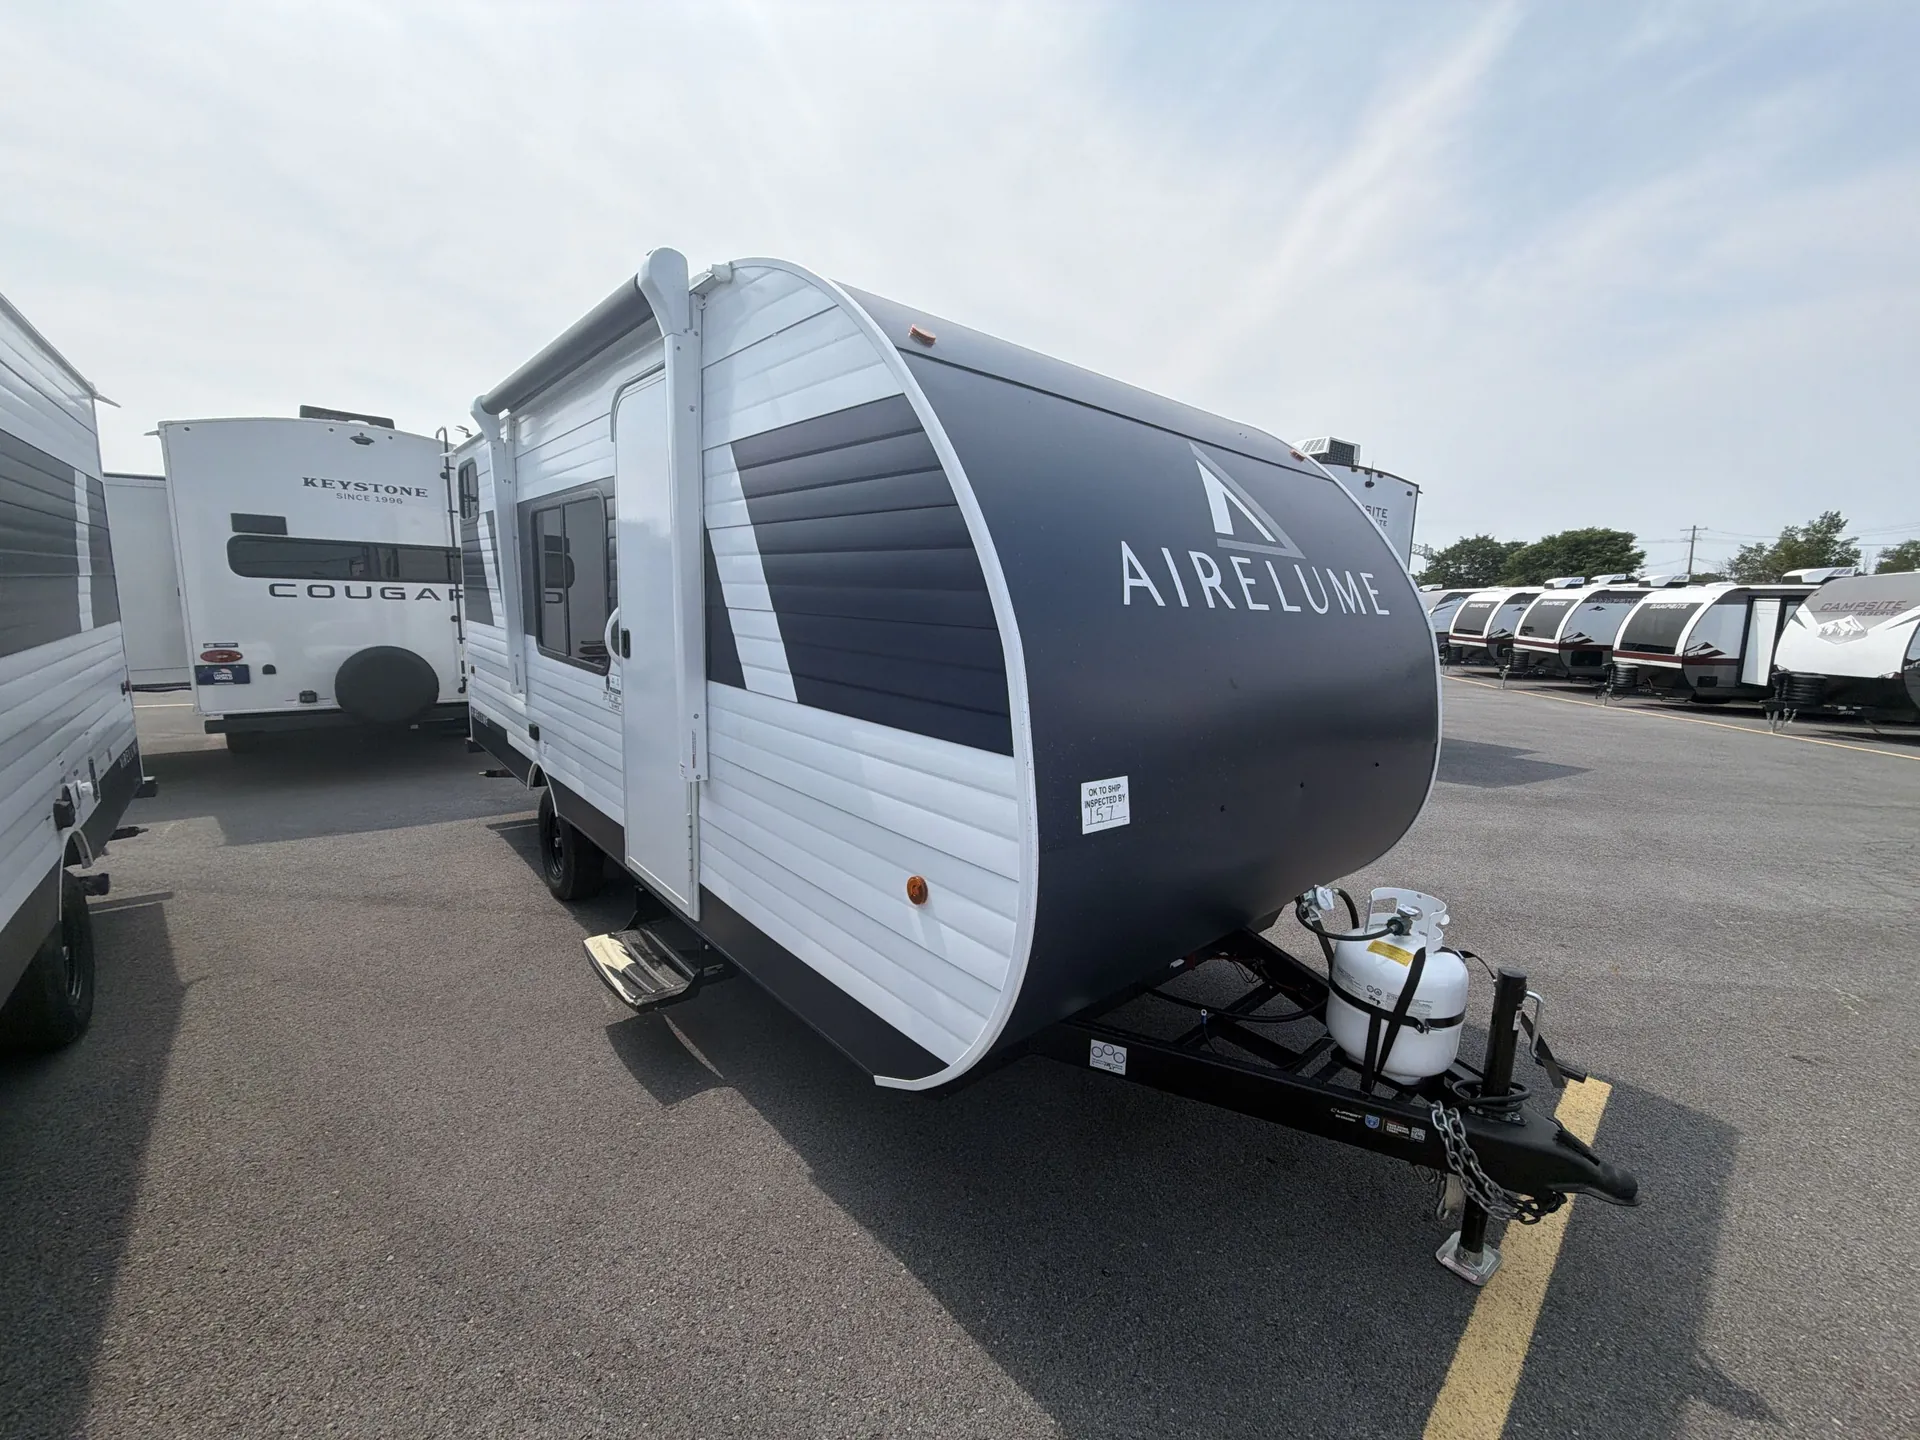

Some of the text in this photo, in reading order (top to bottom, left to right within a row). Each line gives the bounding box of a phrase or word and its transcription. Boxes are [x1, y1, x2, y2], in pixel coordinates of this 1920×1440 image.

[302, 476, 428, 498] KEYSTONE
[336, 492, 403, 505] SINCE 1996
[1365, 505, 1388, 518] SITE
[1121, 540, 1390, 616] AIRELUME
[1820, 600, 1907, 611] CAMPSITE
[1088, 784, 1121, 797] OK TO SHIP
[1085, 793, 1126, 808] INSPECTED BY
